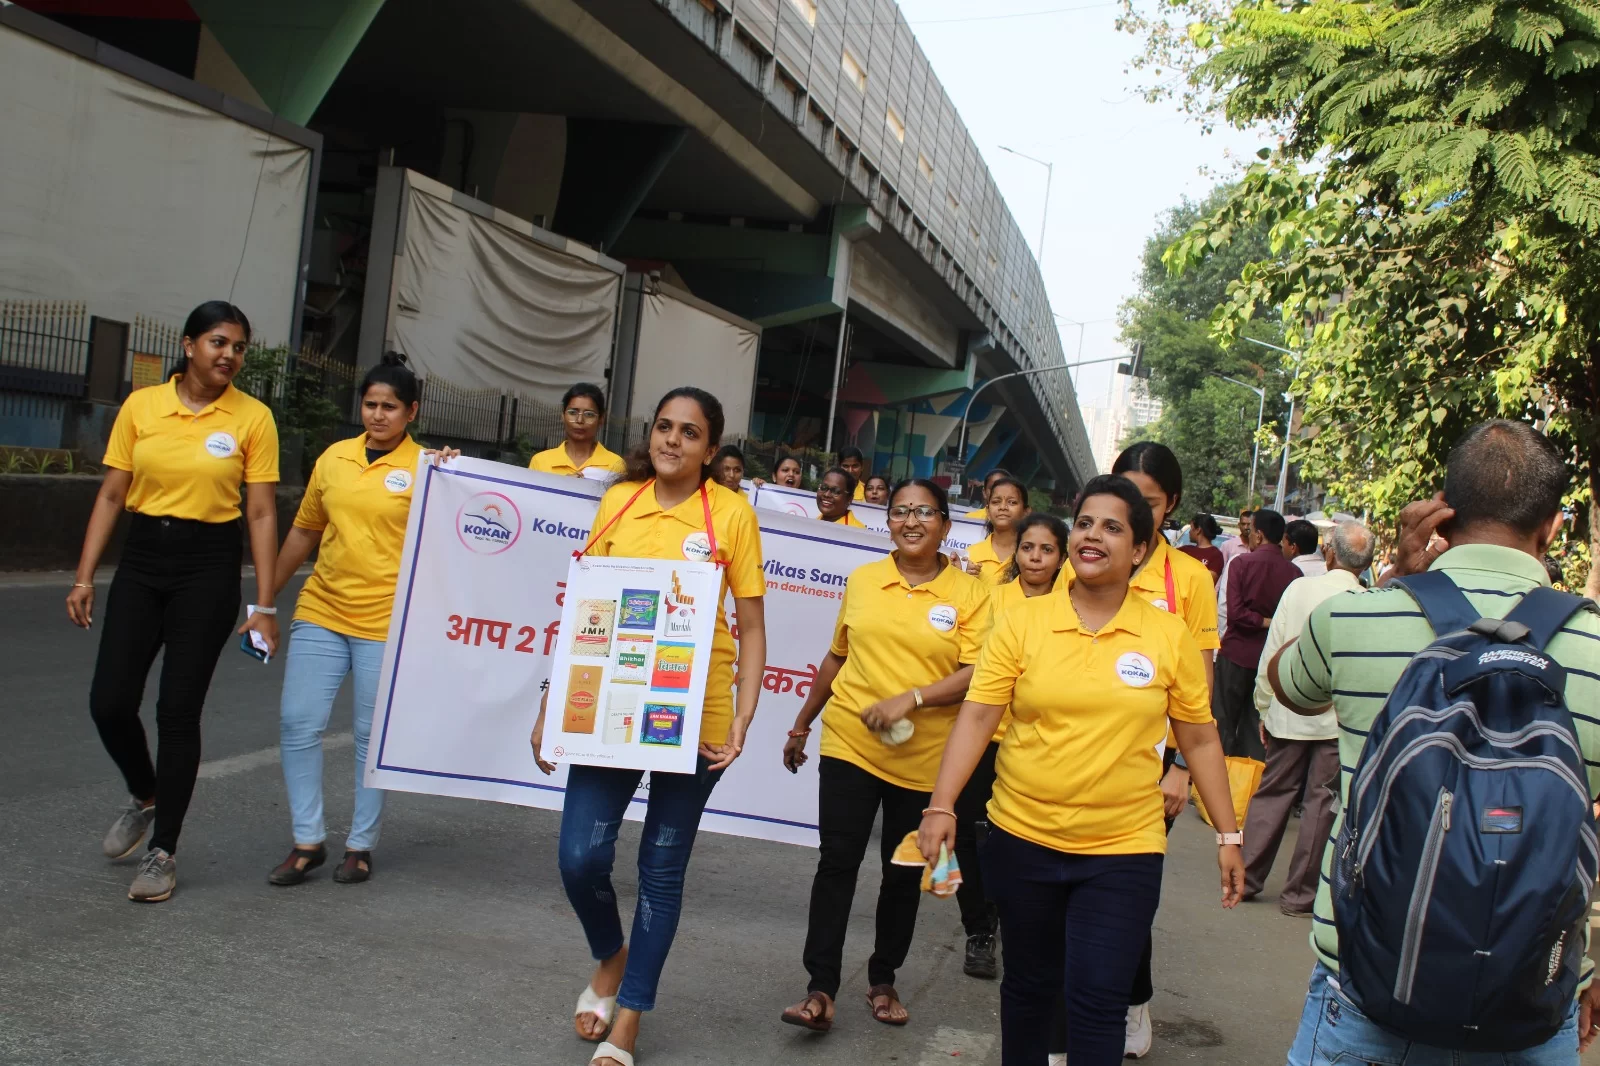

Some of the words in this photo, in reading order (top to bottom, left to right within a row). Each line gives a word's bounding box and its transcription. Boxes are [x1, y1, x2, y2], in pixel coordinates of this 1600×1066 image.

[463, 524, 511, 540] KOKAN
[780, 581, 836, 599] darkness
[931, 616, 954, 626] KOKAN
[446, 614, 512, 650] आप
[514, 625, 536, 654] 2
[580, 626, 606, 636] JMH
[1478, 649, 1549, 665] AMERICAN
[1478, 654, 1547, 670] TOURISTER
[1121, 668, 1150, 679] KOKAN
